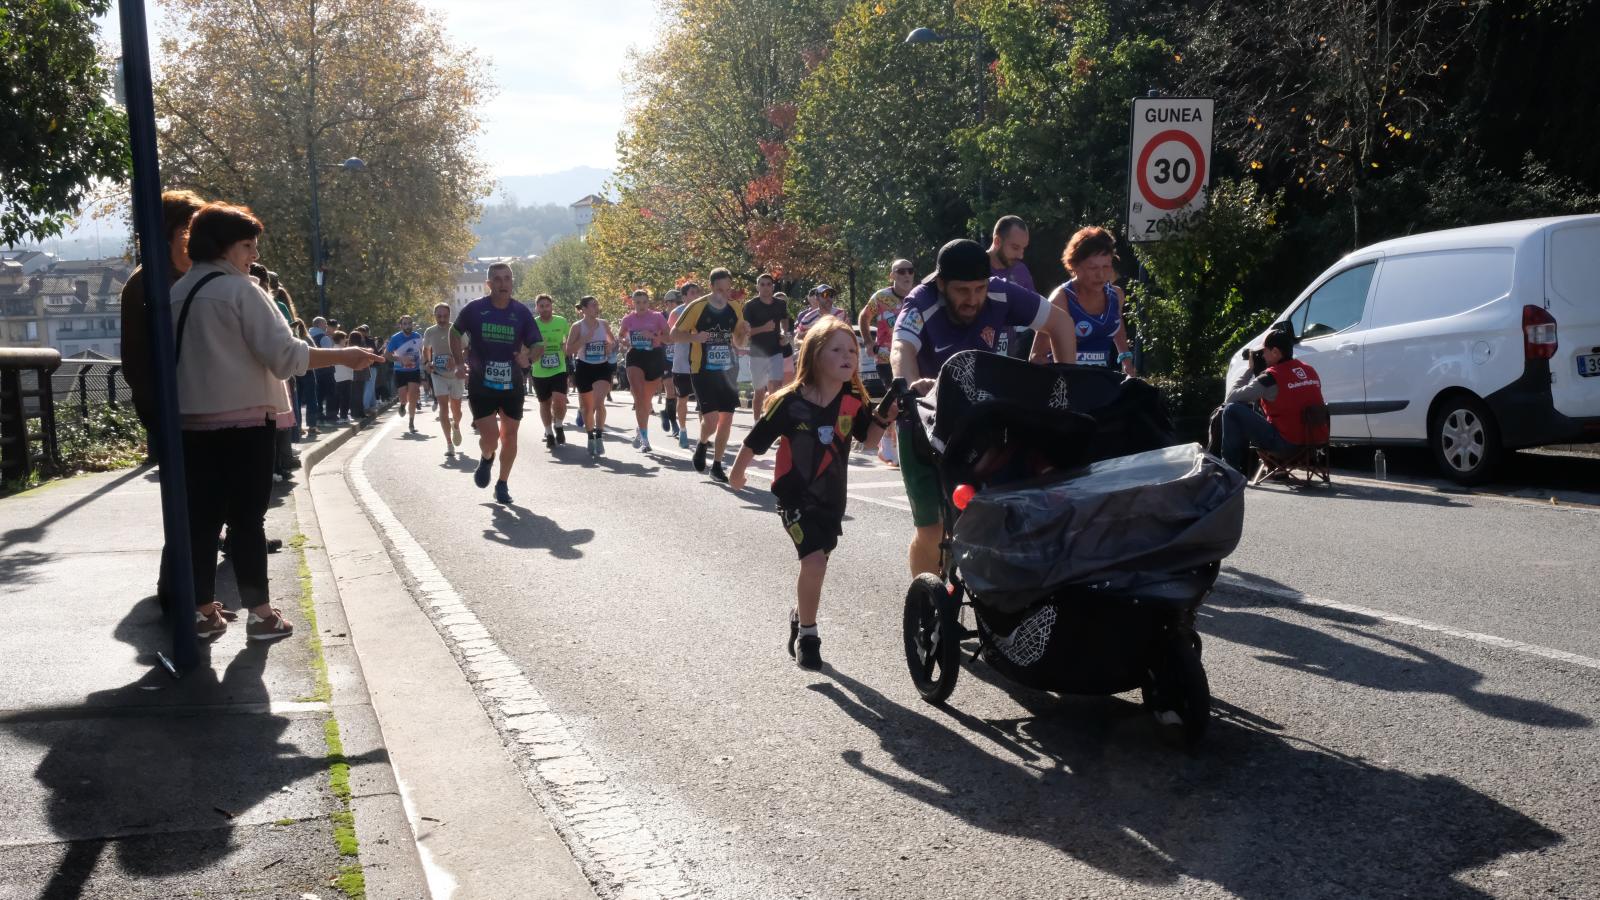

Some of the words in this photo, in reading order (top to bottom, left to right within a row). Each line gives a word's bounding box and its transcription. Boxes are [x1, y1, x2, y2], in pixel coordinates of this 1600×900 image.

[1145, 107, 1203, 122] GUNEA
[1153, 157, 1191, 184] 30
[486, 367, 511, 378] 6941
